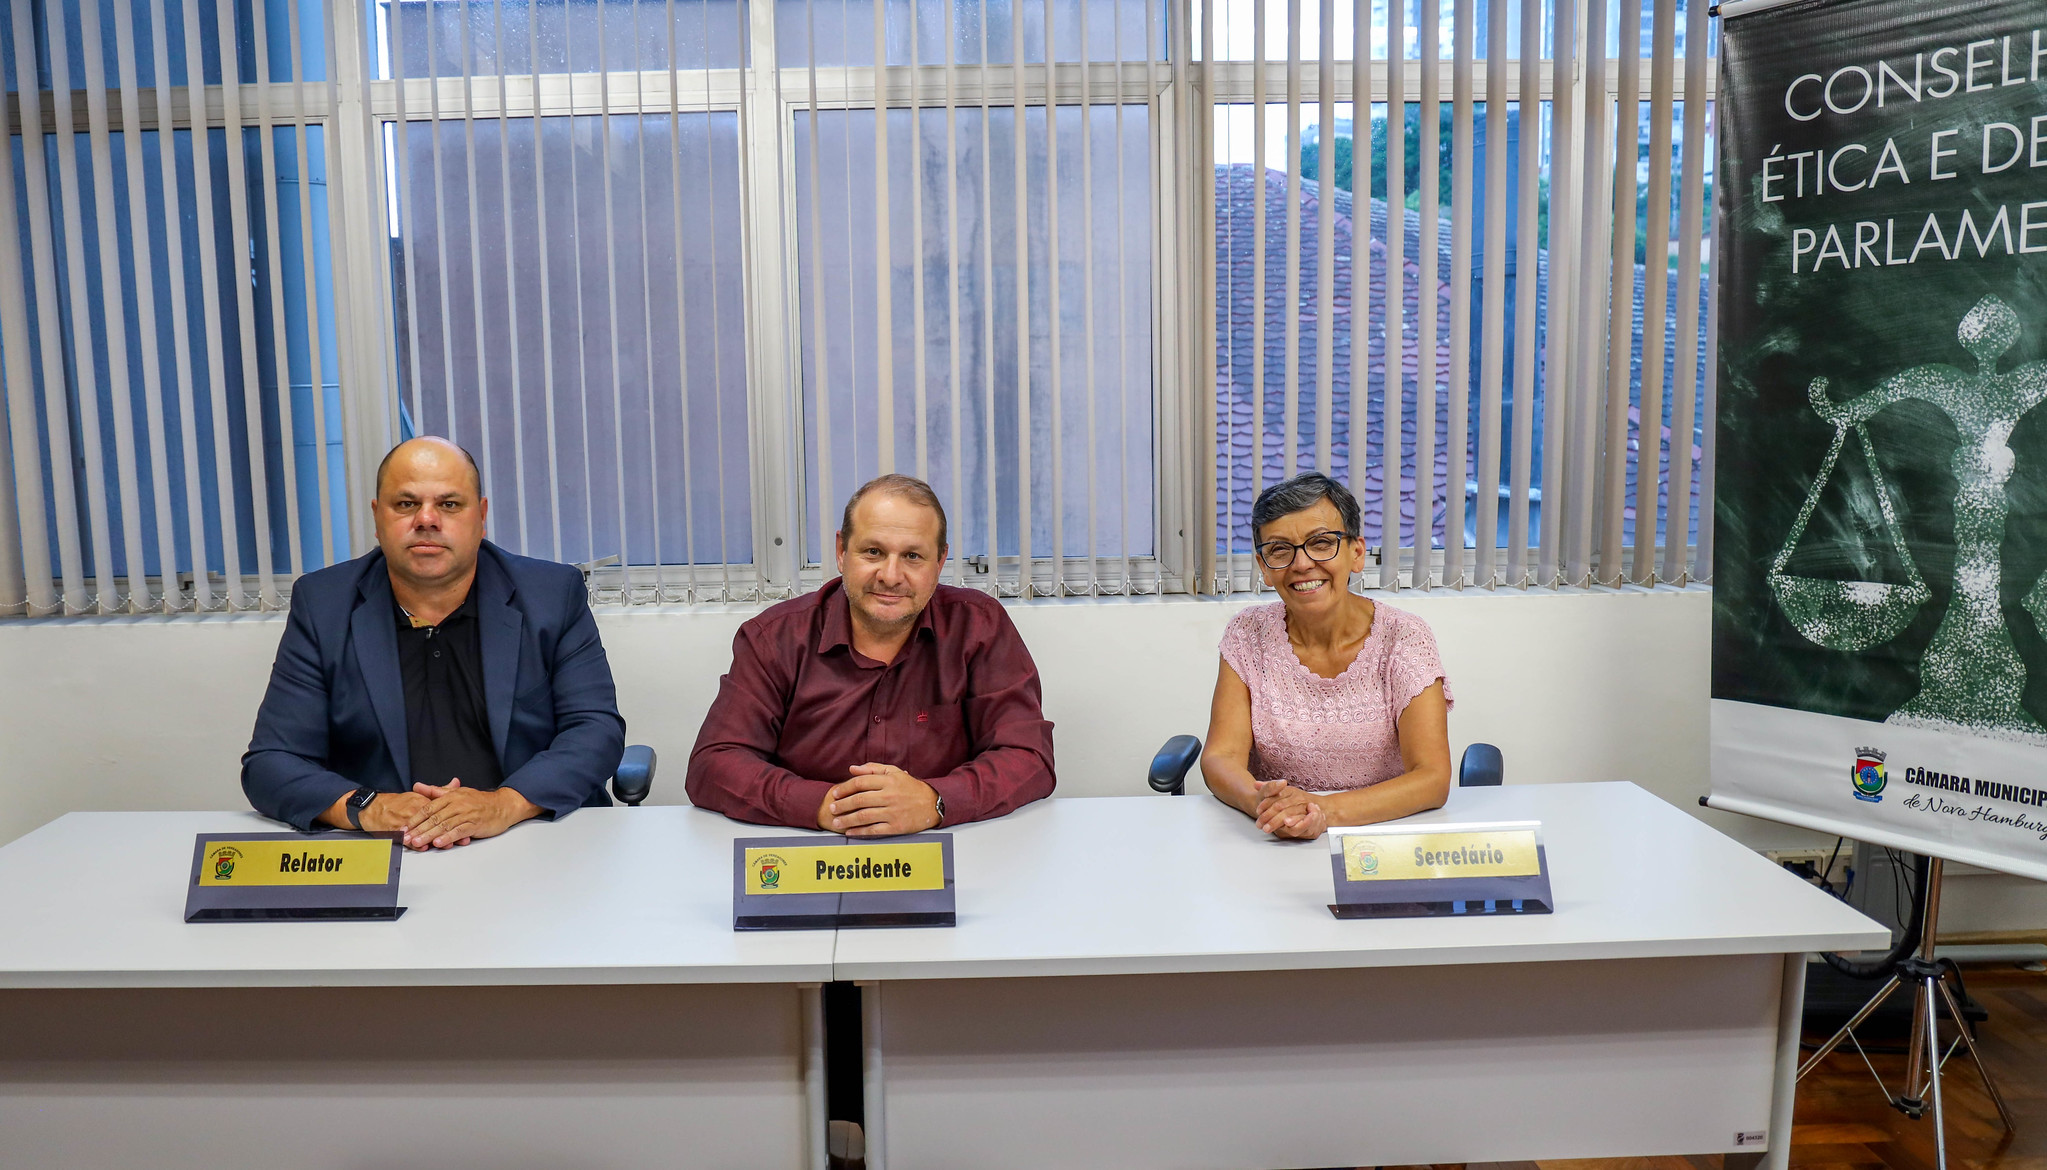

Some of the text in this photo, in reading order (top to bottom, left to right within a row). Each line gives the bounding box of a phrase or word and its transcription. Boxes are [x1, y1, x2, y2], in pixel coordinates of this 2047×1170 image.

[1762, 115, 2047, 203] ÉTICA E DE
[1792, 201, 2047, 274] PARLAME
[1905, 766, 1970, 794] CÂMARA
[1903, 793, 1921, 809] de
[1919, 797, 1967, 816] Novo
[280, 852, 343, 872] Relator
[1414, 843, 1504, 867] Secretário
[816, 857, 912, 880] Presidente
